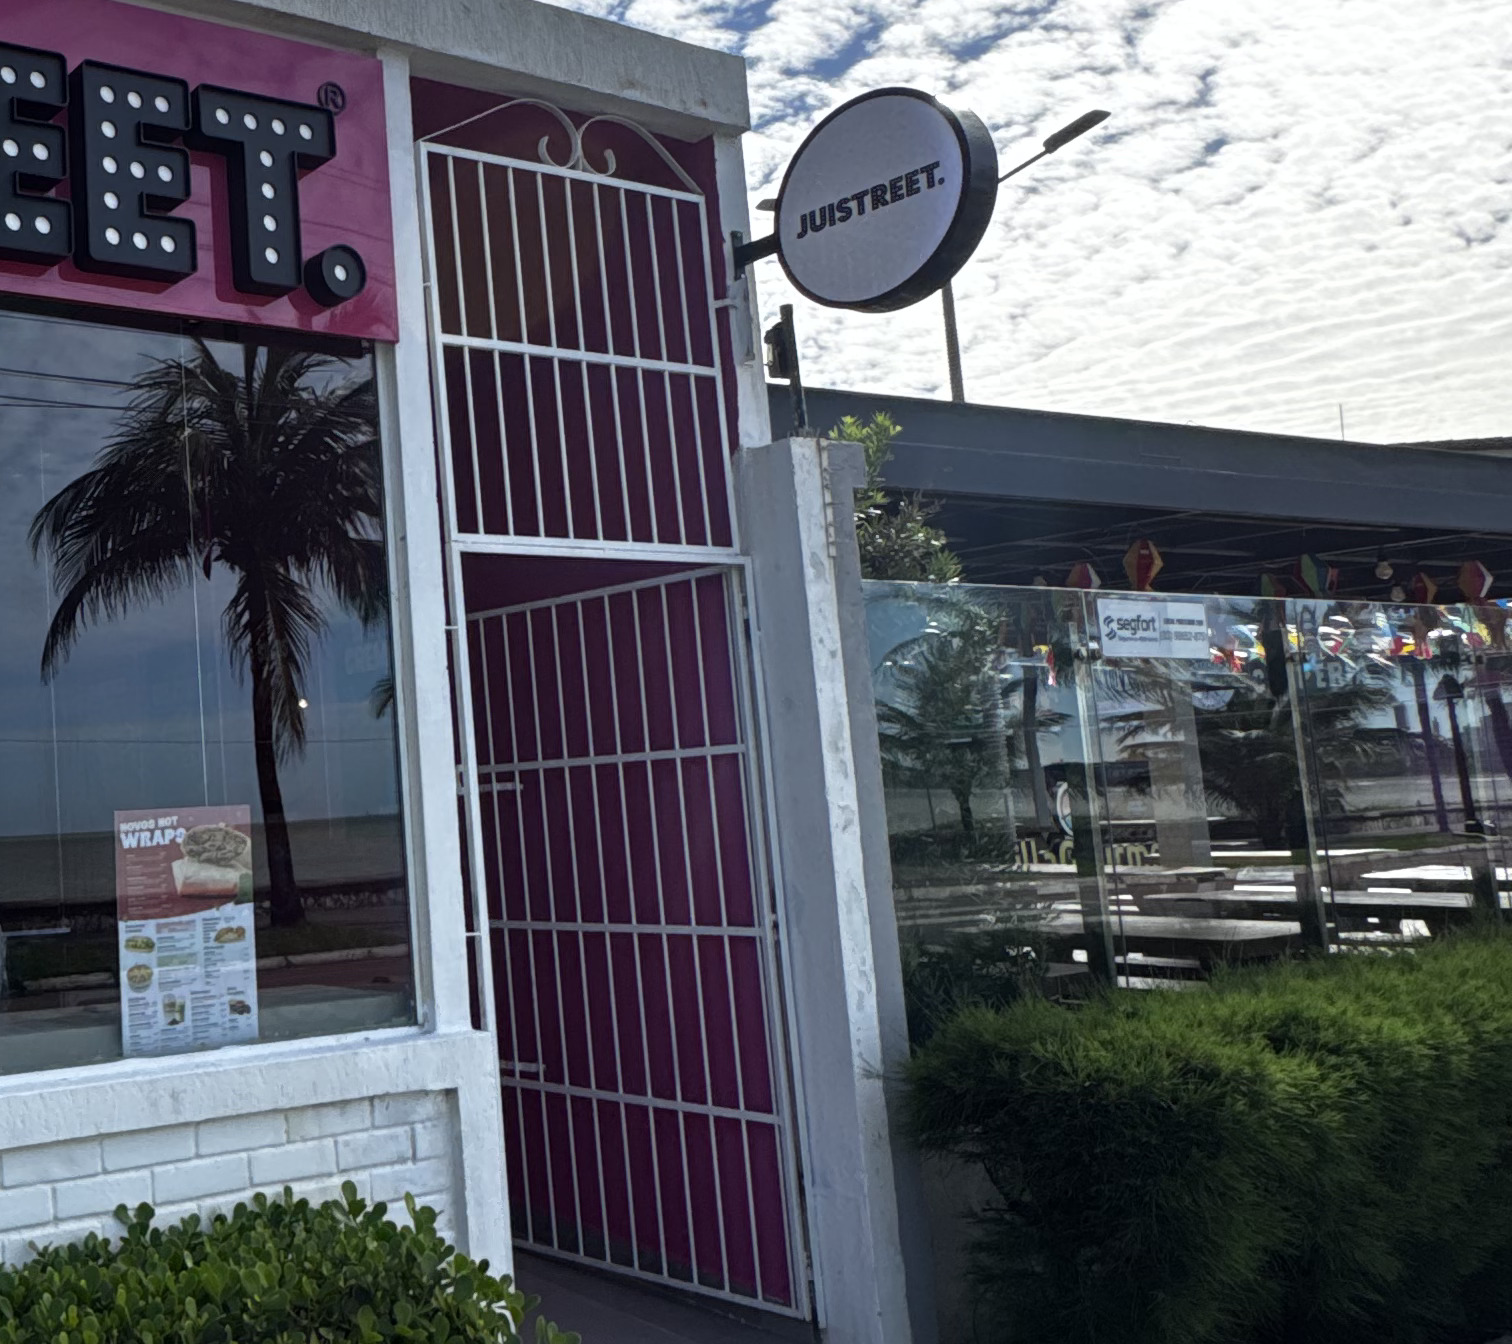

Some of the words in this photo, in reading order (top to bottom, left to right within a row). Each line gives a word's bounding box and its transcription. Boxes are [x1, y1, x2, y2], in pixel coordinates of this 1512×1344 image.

[796, 160, 945, 240] JUISTREET.
[1116, 614, 1157, 635] segfort
[120, 828, 186, 849] WRAPS
